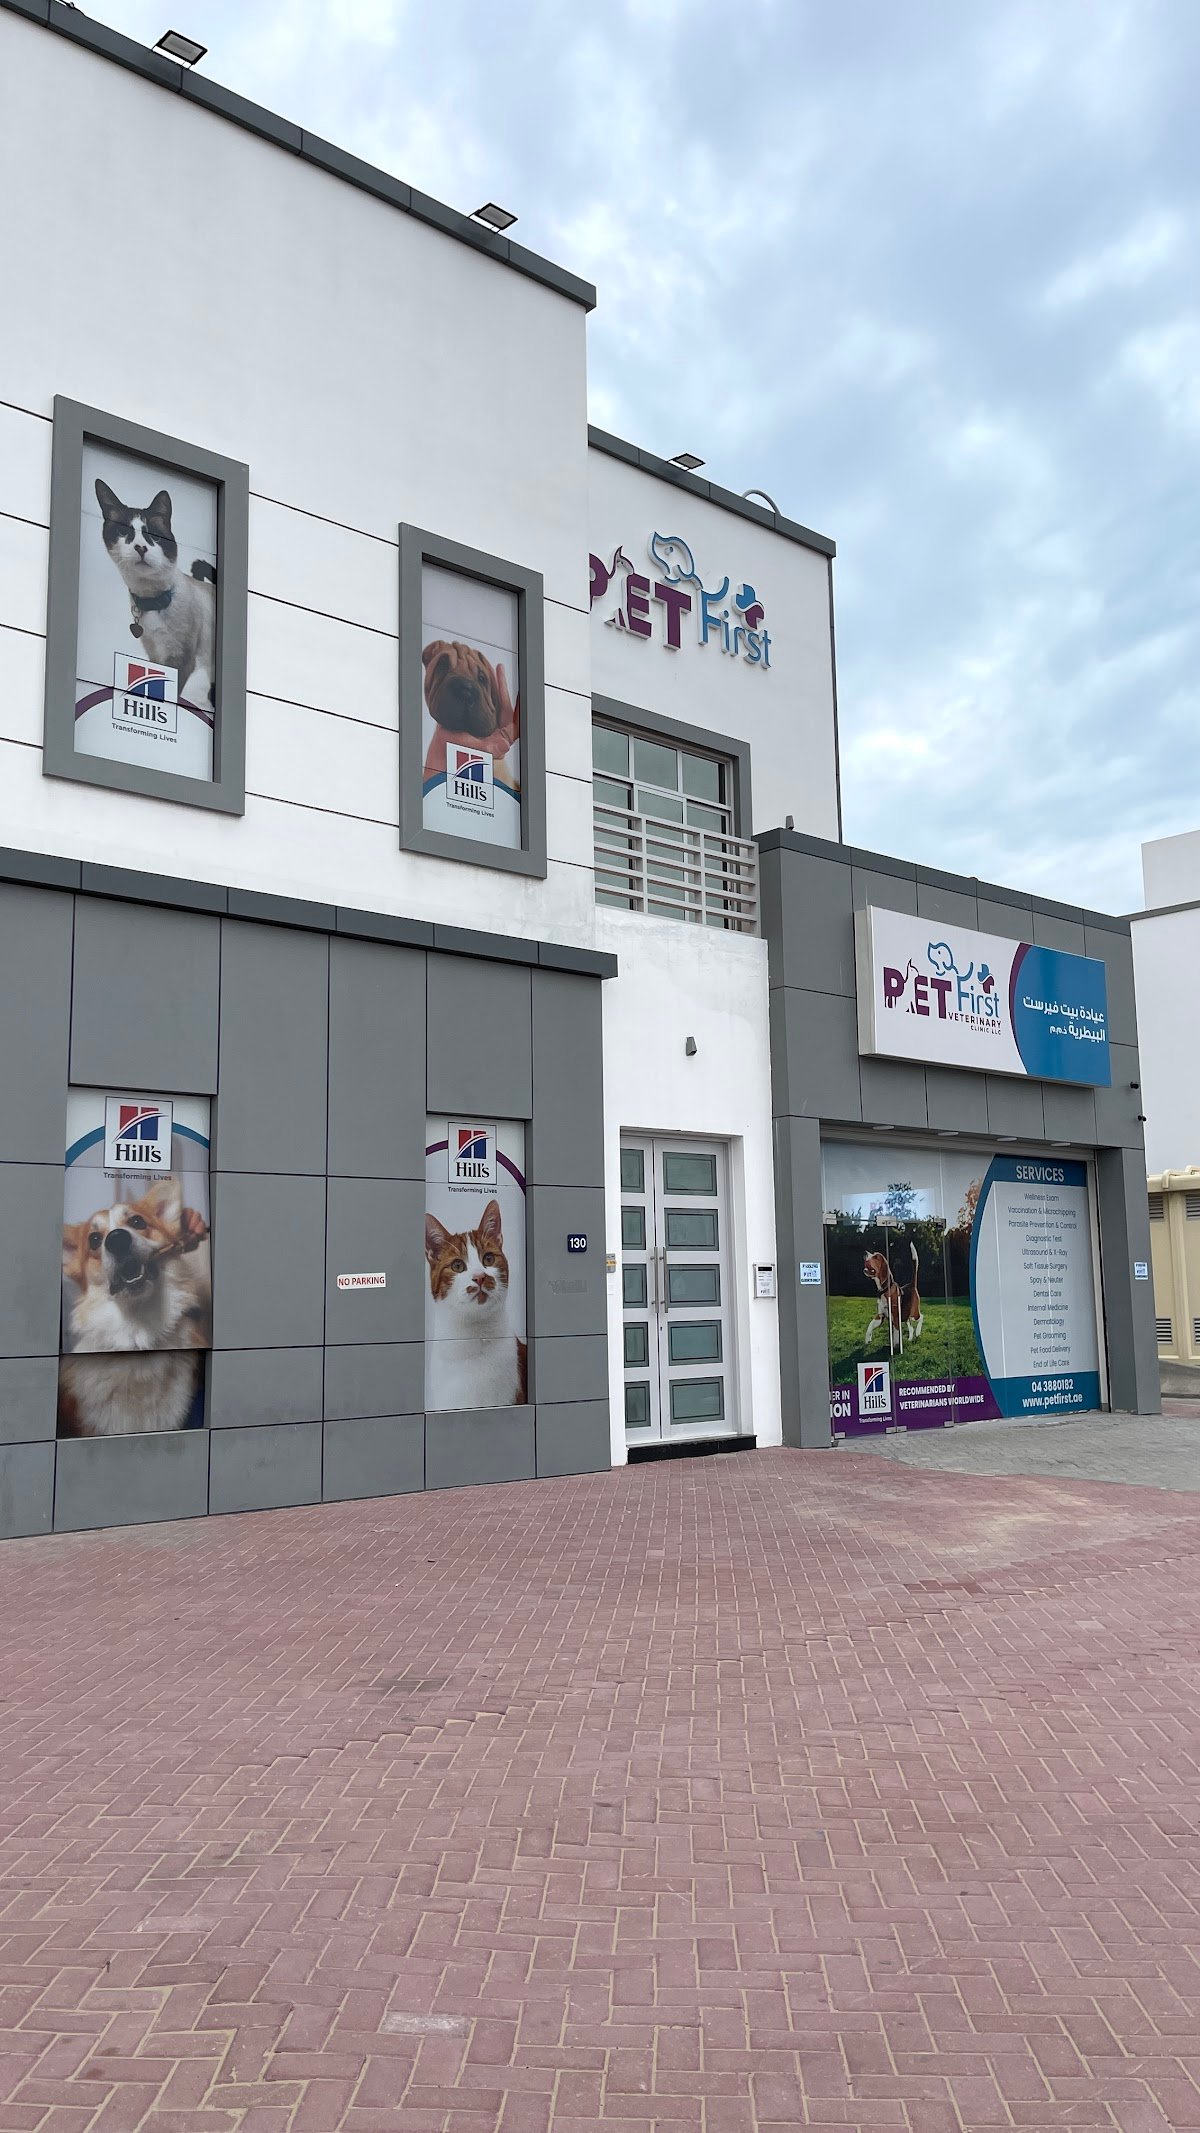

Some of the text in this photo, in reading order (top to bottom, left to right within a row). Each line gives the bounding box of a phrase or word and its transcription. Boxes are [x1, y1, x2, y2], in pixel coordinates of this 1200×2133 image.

[698, 588, 772, 670] First
[122, 698, 168, 724] Hill's
[111, 722, 178, 744] Transforming Lives
[454, 780, 487, 802] Hill's
[446, 801, 495, 818] Transforming Lives
[883, 966, 1000, 1019] PET First
[1023, 996, 1105, 1023] عيادة بيت فيرست
[947, 1011, 1002, 1029] VETERINARY
[970, 1025, 990, 1034] CLINIC
[1068, 1020, 1106, 1043] البيطرية
[115, 1143, 162, 1163] Hill's
[456, 1161, 490, 1179] Hill's
[1015, 1165, 1065, 1182] SERVICES
[103, 1172, 152, 1181] Transforming
[447, 1186, 483, 1194] Transforming
[1024, 1192, 1060, 1202] Wellness Exam
[1007, 1206, 1038, 1214] Vaccination
[1008, 1220, 1029, 1228] Parasite
[1029, 1221, 1055, 1229] Prevention
[569, 1237, 587, 1249] 130
[1026, 1234, 1062, 1244] Diagnostic Test
[1021, 1248, 1049, 1256] Ultrasound
[1023, 1262, 1068, 1272] Soft Tissue Surgery
[338, 1276, 385, 1286] NO PARKING
[1029, 1276, 1042, 1285] Spay
[1042, 1276, 1048, 1284] &
[1033, 1290, 1050, 1298] Dental
[1027, 1304, 1047, 1312] Internal
[1033, 1318, 1065, 1327] Dermatology
[1033, 1332, 1067, 1341] Pet Grooming
[1030, 1345, 1071, 1355] Pet Food Delivery
[1033, 1359, 1070, 1369] End of Life Care
[899, 1384, 955, 1396] RECOMMENDED BY
[1031, 1378, 1074, 1393] 04 3880182
[841, 1390, 850, 1400] IN
[863, 1394, 887, 1409] Hill's
[899, 1394, 985, 1410] VETERINARIANS WORLDWIDE
[1022, 1393, 1083, 1409] www.petfirst.ae
